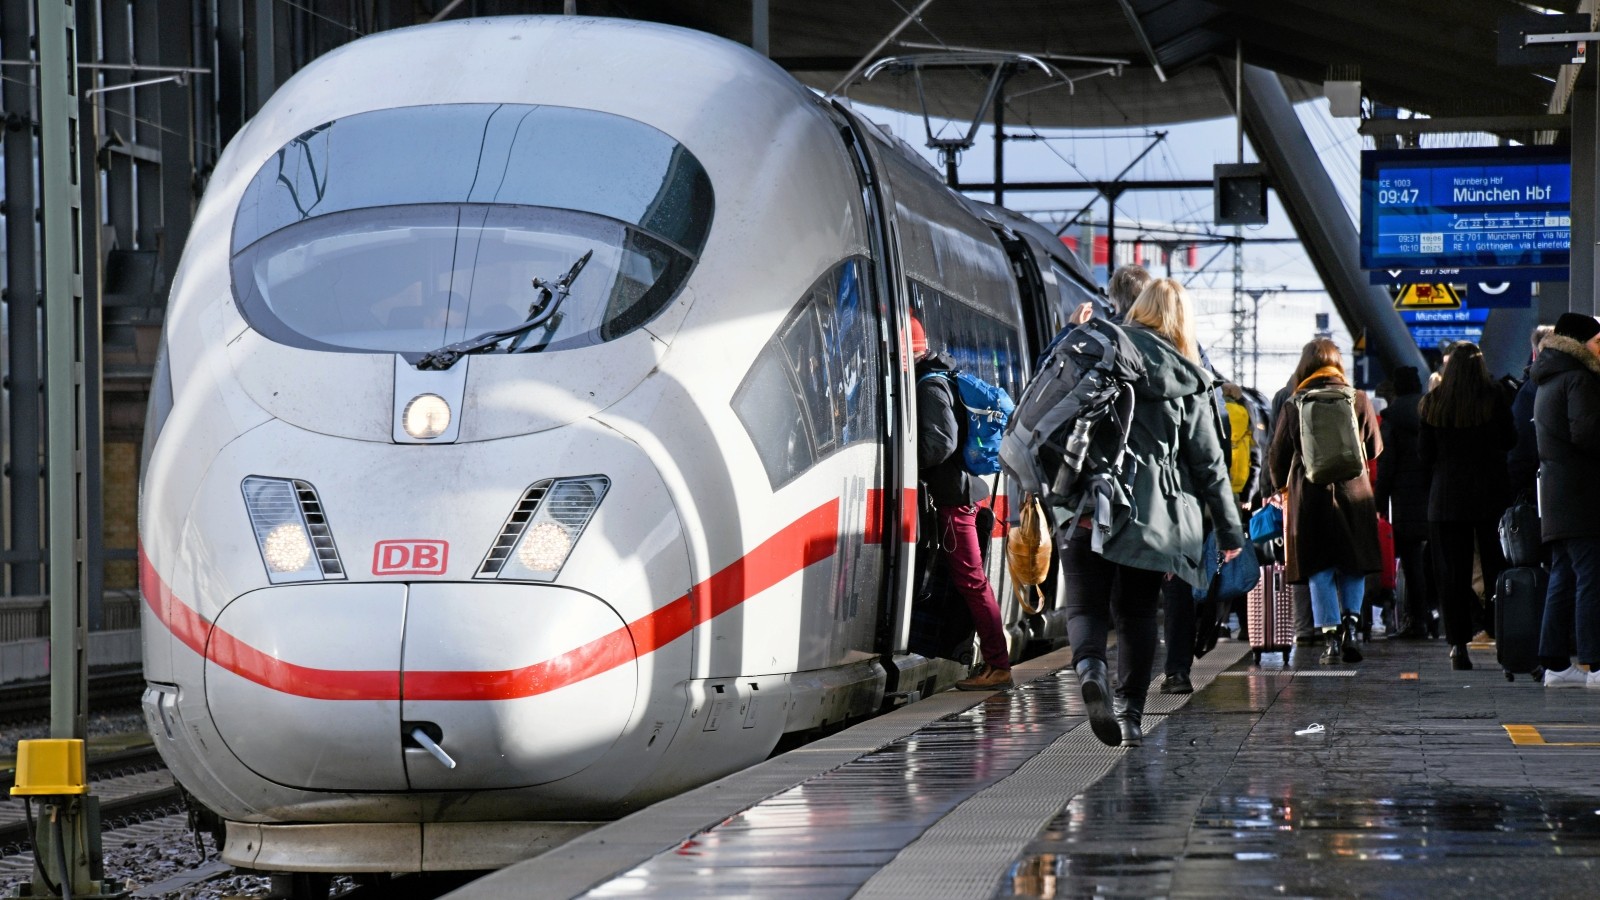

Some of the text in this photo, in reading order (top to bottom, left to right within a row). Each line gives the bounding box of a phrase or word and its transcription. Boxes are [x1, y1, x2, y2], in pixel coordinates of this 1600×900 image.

[1454, 178, 1488, 186] Nürnberg
[1379, 190, 1418, 204] 09:47
[1454, 186, 1552, 202] München Hbf
[1476, 242, 1513, 251] Göttingen
[382, 545, 438, 569] DB
